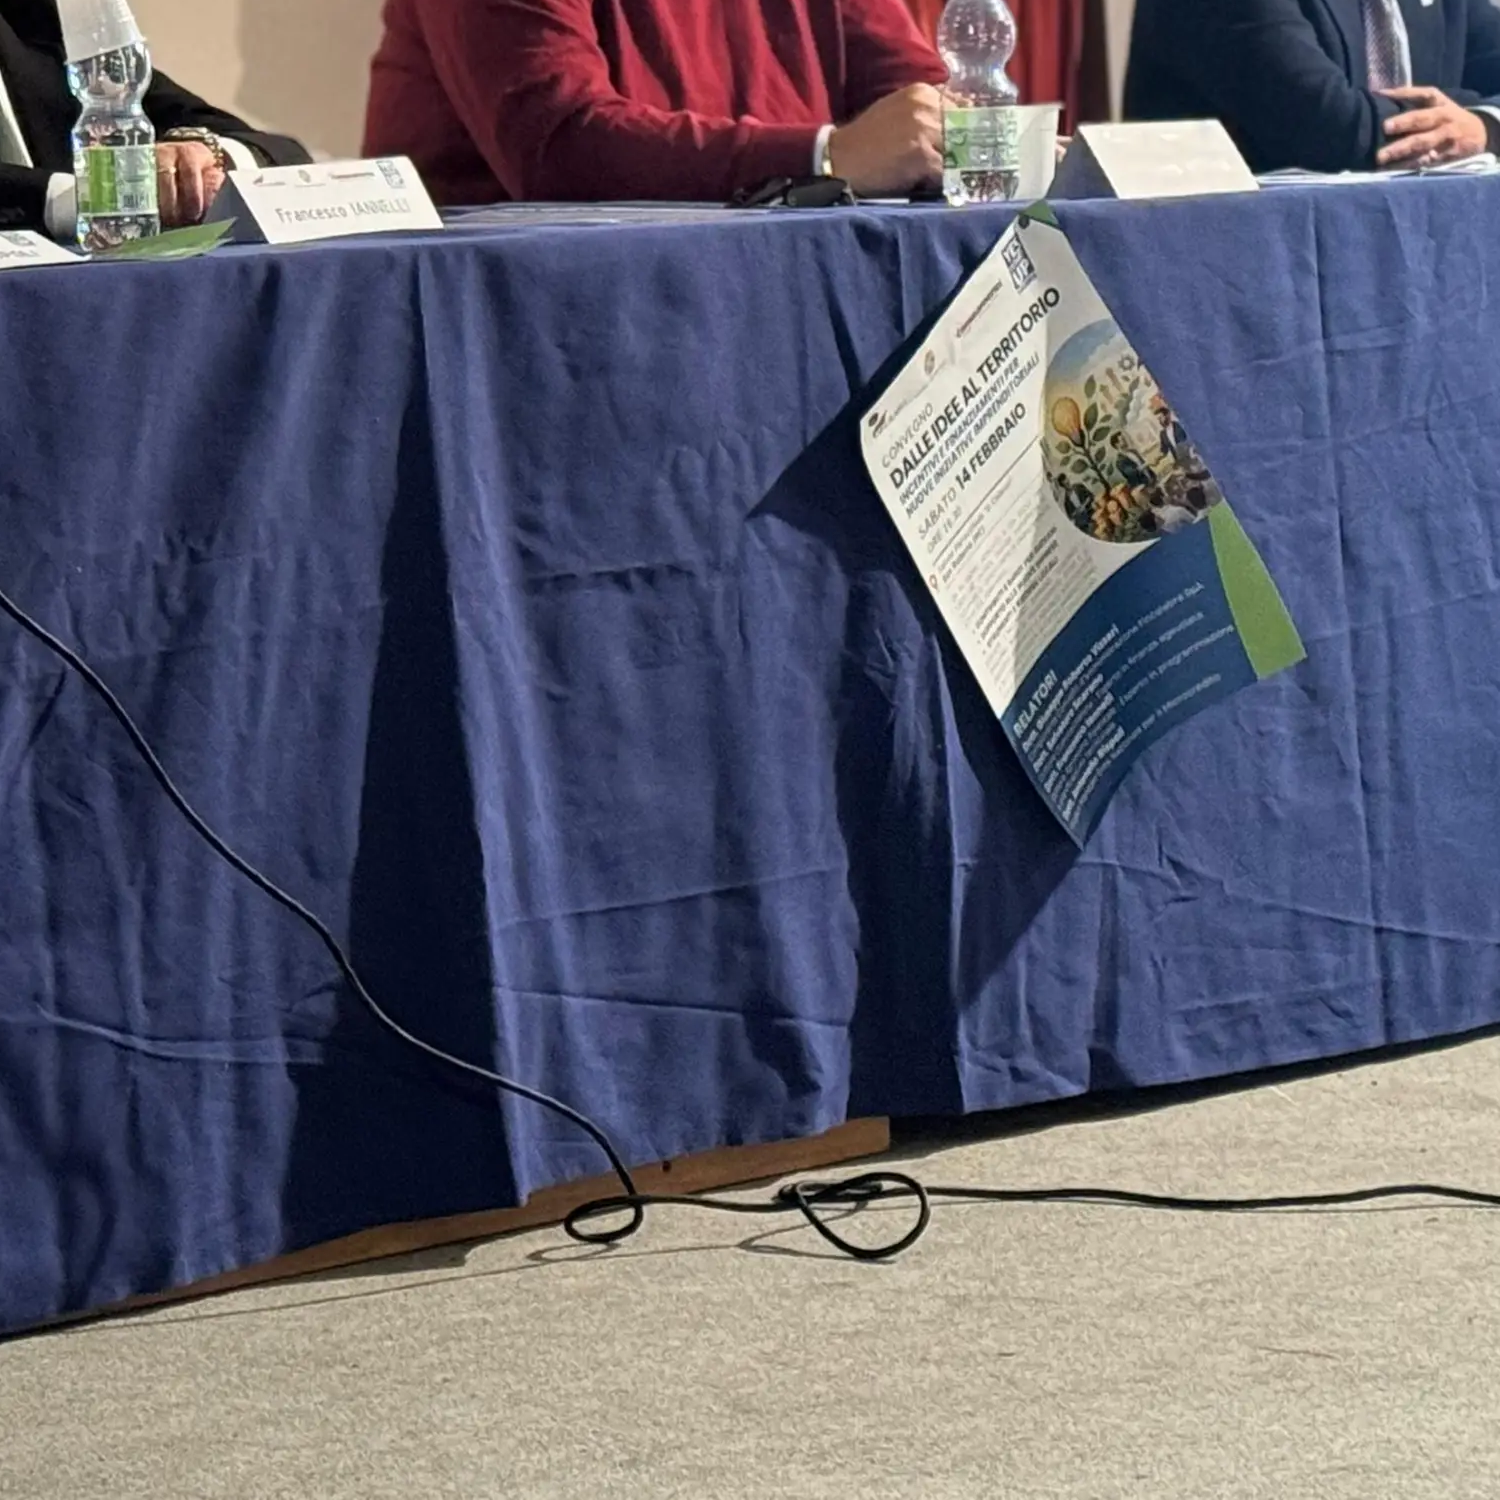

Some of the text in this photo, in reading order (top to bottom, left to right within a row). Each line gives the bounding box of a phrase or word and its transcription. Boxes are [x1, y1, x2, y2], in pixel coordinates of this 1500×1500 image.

[275, 199, 411, 224] Francesco IANNELLI
[1003, 237, 1019, 265] YES
[1013, 257, 1031, 285] UP
[889, 429, 934, 490] DALLE
[930, 395, 964, 441] IDEE
[958, 374, 981, 407] AL
[976, 282, 1061, 385] TERRITORIO
[880, 401, 934, 469] CONVEGNO
[899, 452, 940, 505] INCENTIVI
[944, 374, 1005, 451] FINANZIAMENTI
[1003, 356, 1020, 379] PER
[905, 477, 934, 518] NUOVE
[932, 431, 974, 484] INIZIATIVE
[972, 351, 1039, 436] IMPRENDITORIALI
[916, 485, 957, 540] SABATO
[955, 465, 970, 490] 14
[968, 400, 1026, 474] FEBBRAIO
[1013, 669, 1056, 738] RELATORI
